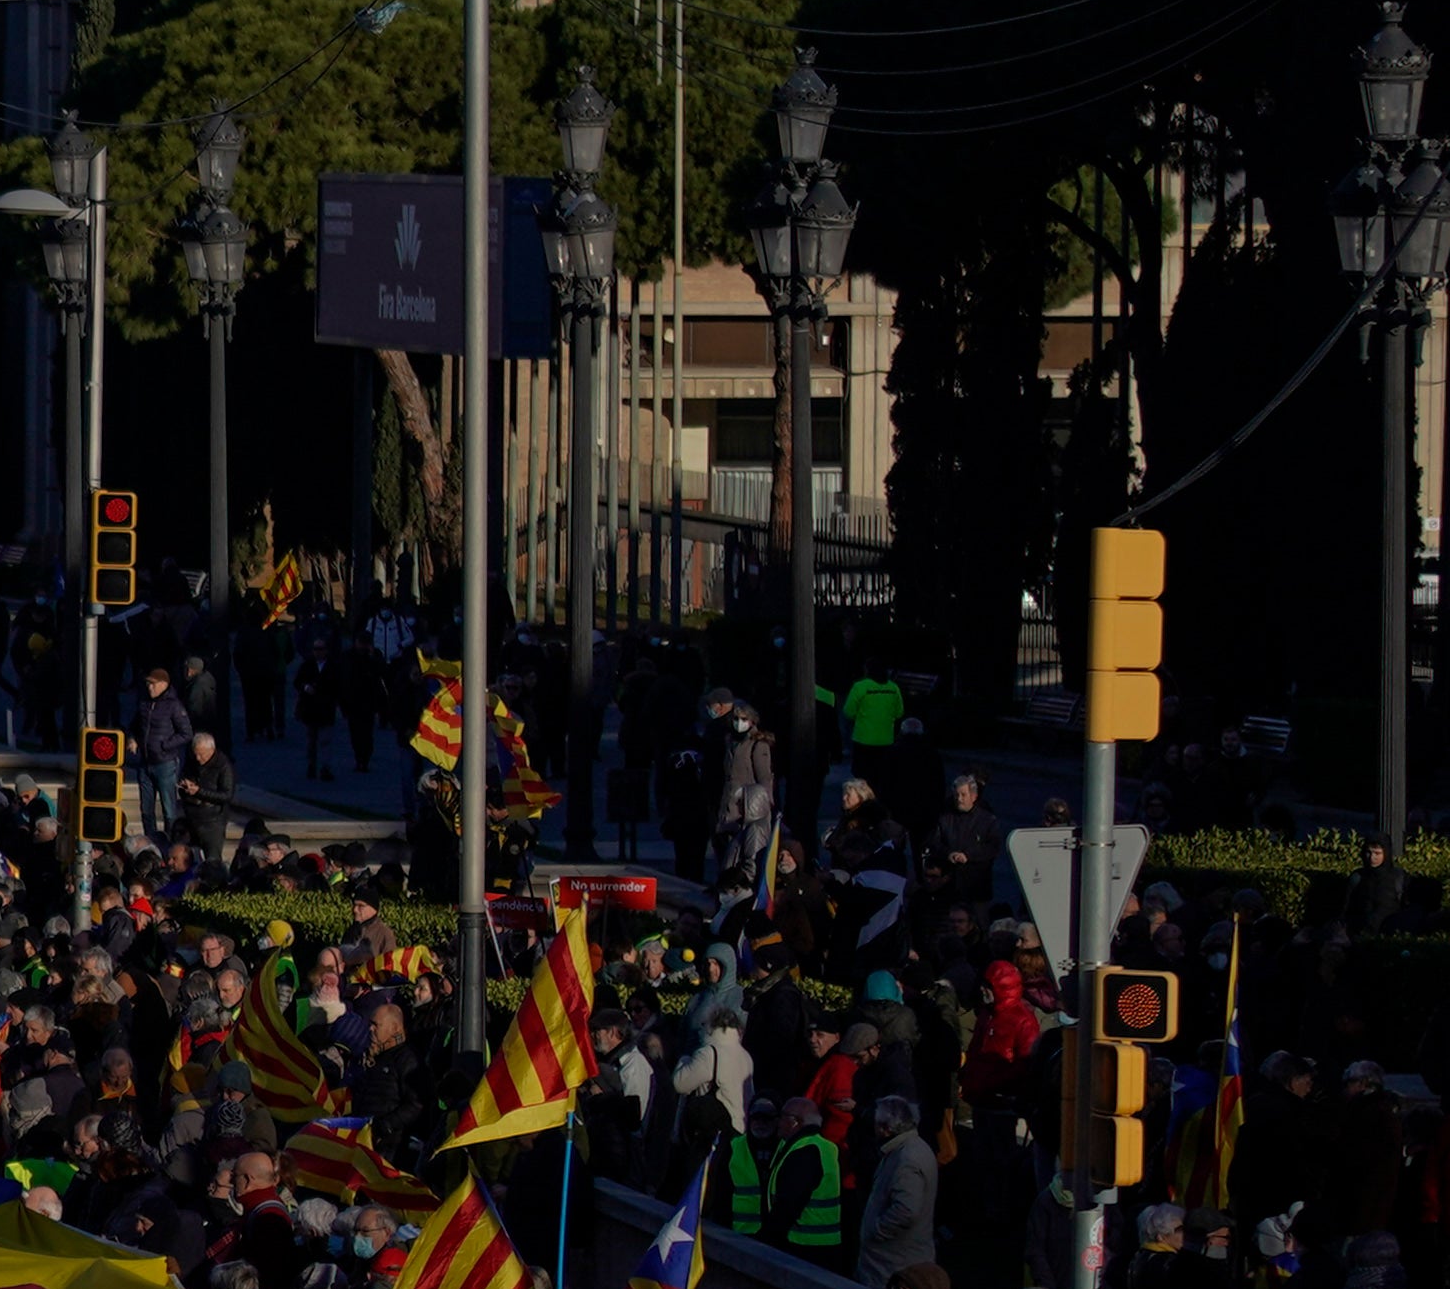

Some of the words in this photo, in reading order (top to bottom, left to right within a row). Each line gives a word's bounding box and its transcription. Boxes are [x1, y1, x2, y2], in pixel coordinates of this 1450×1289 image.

[378, 282, 394, 320] Fira
[396, 285, 436, 322] Barcelona
[570, 880, 587, 892] No
[590, 880, 648, 894] surrender
